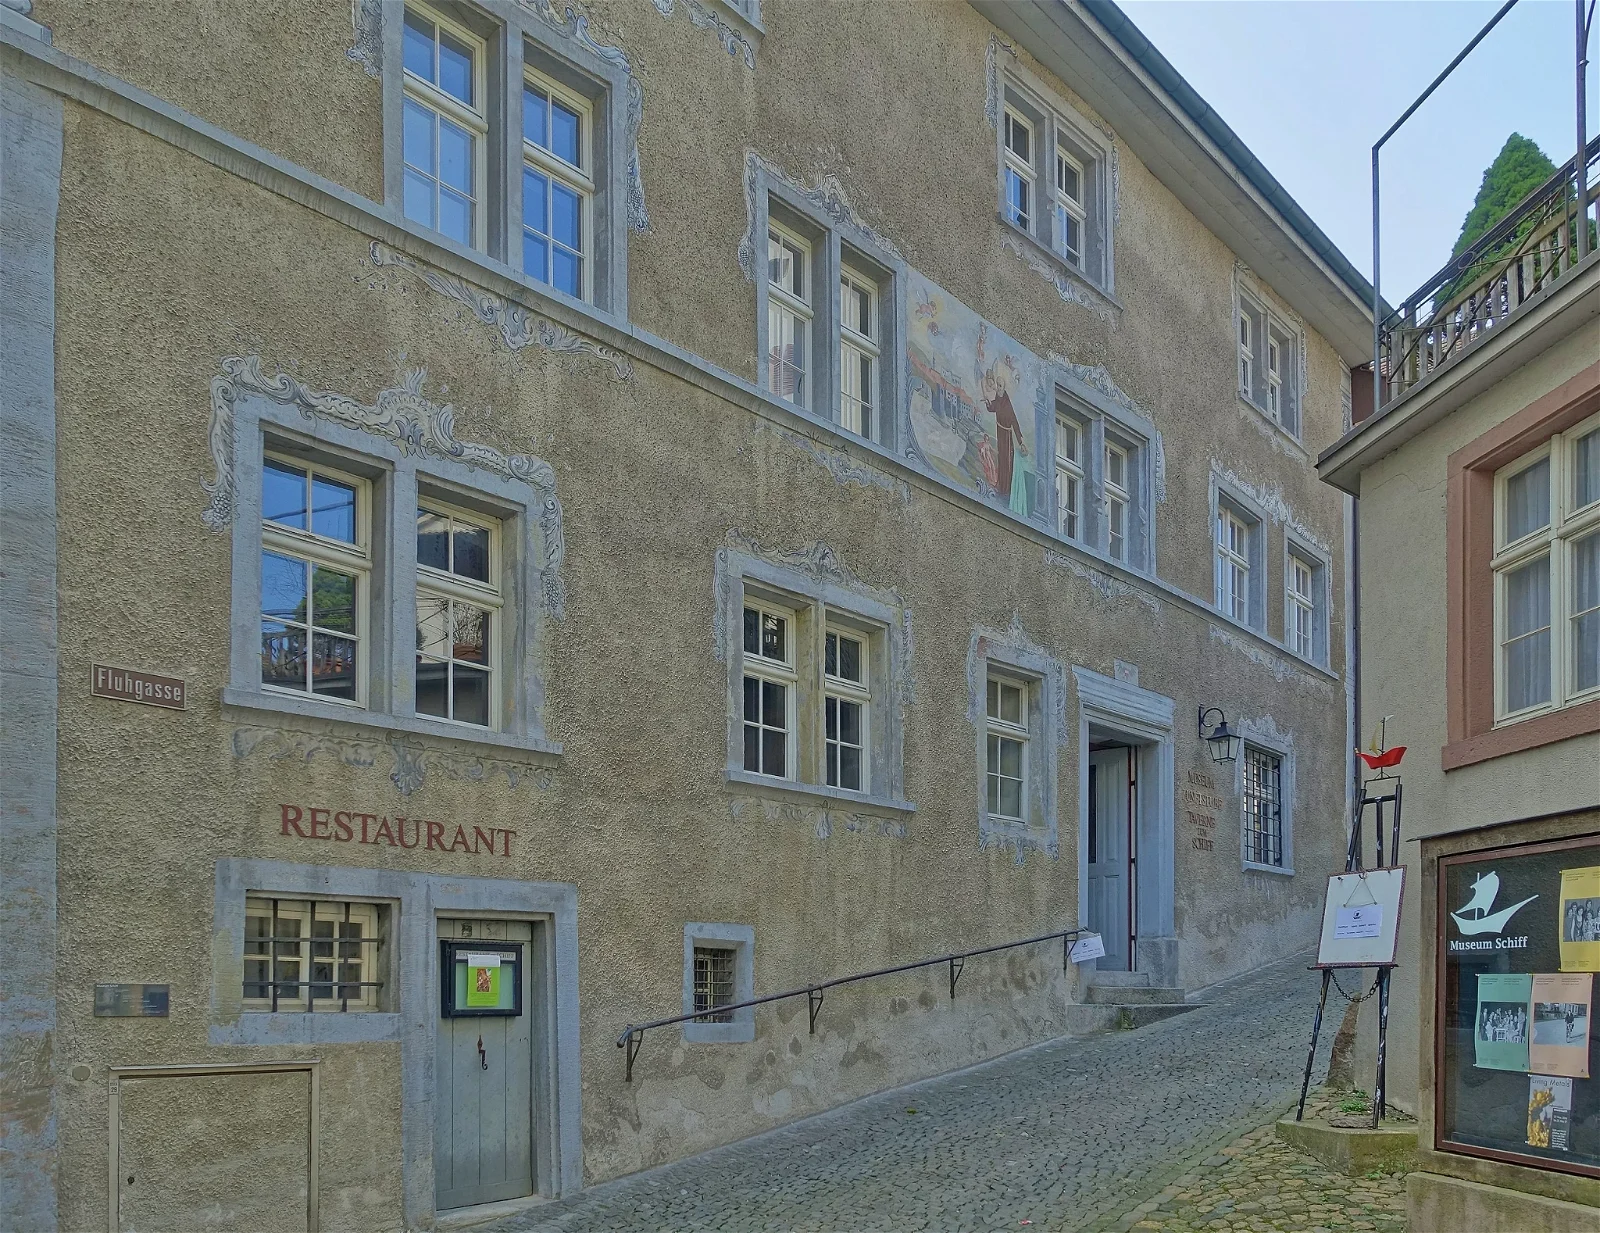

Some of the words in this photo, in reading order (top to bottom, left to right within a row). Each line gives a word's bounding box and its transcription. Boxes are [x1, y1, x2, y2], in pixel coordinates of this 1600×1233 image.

[98, 667, 181, 701] Fluhgasse
[1187, 770, 1215, 789] MUSEUM
[278, 803, 517, 857] RESTAURANT
[1192, 837, 1214, 851] SCHIFF
[1450, 940, 1492, 951] Museum
[1495, 936, 1528, 949] Schiff
